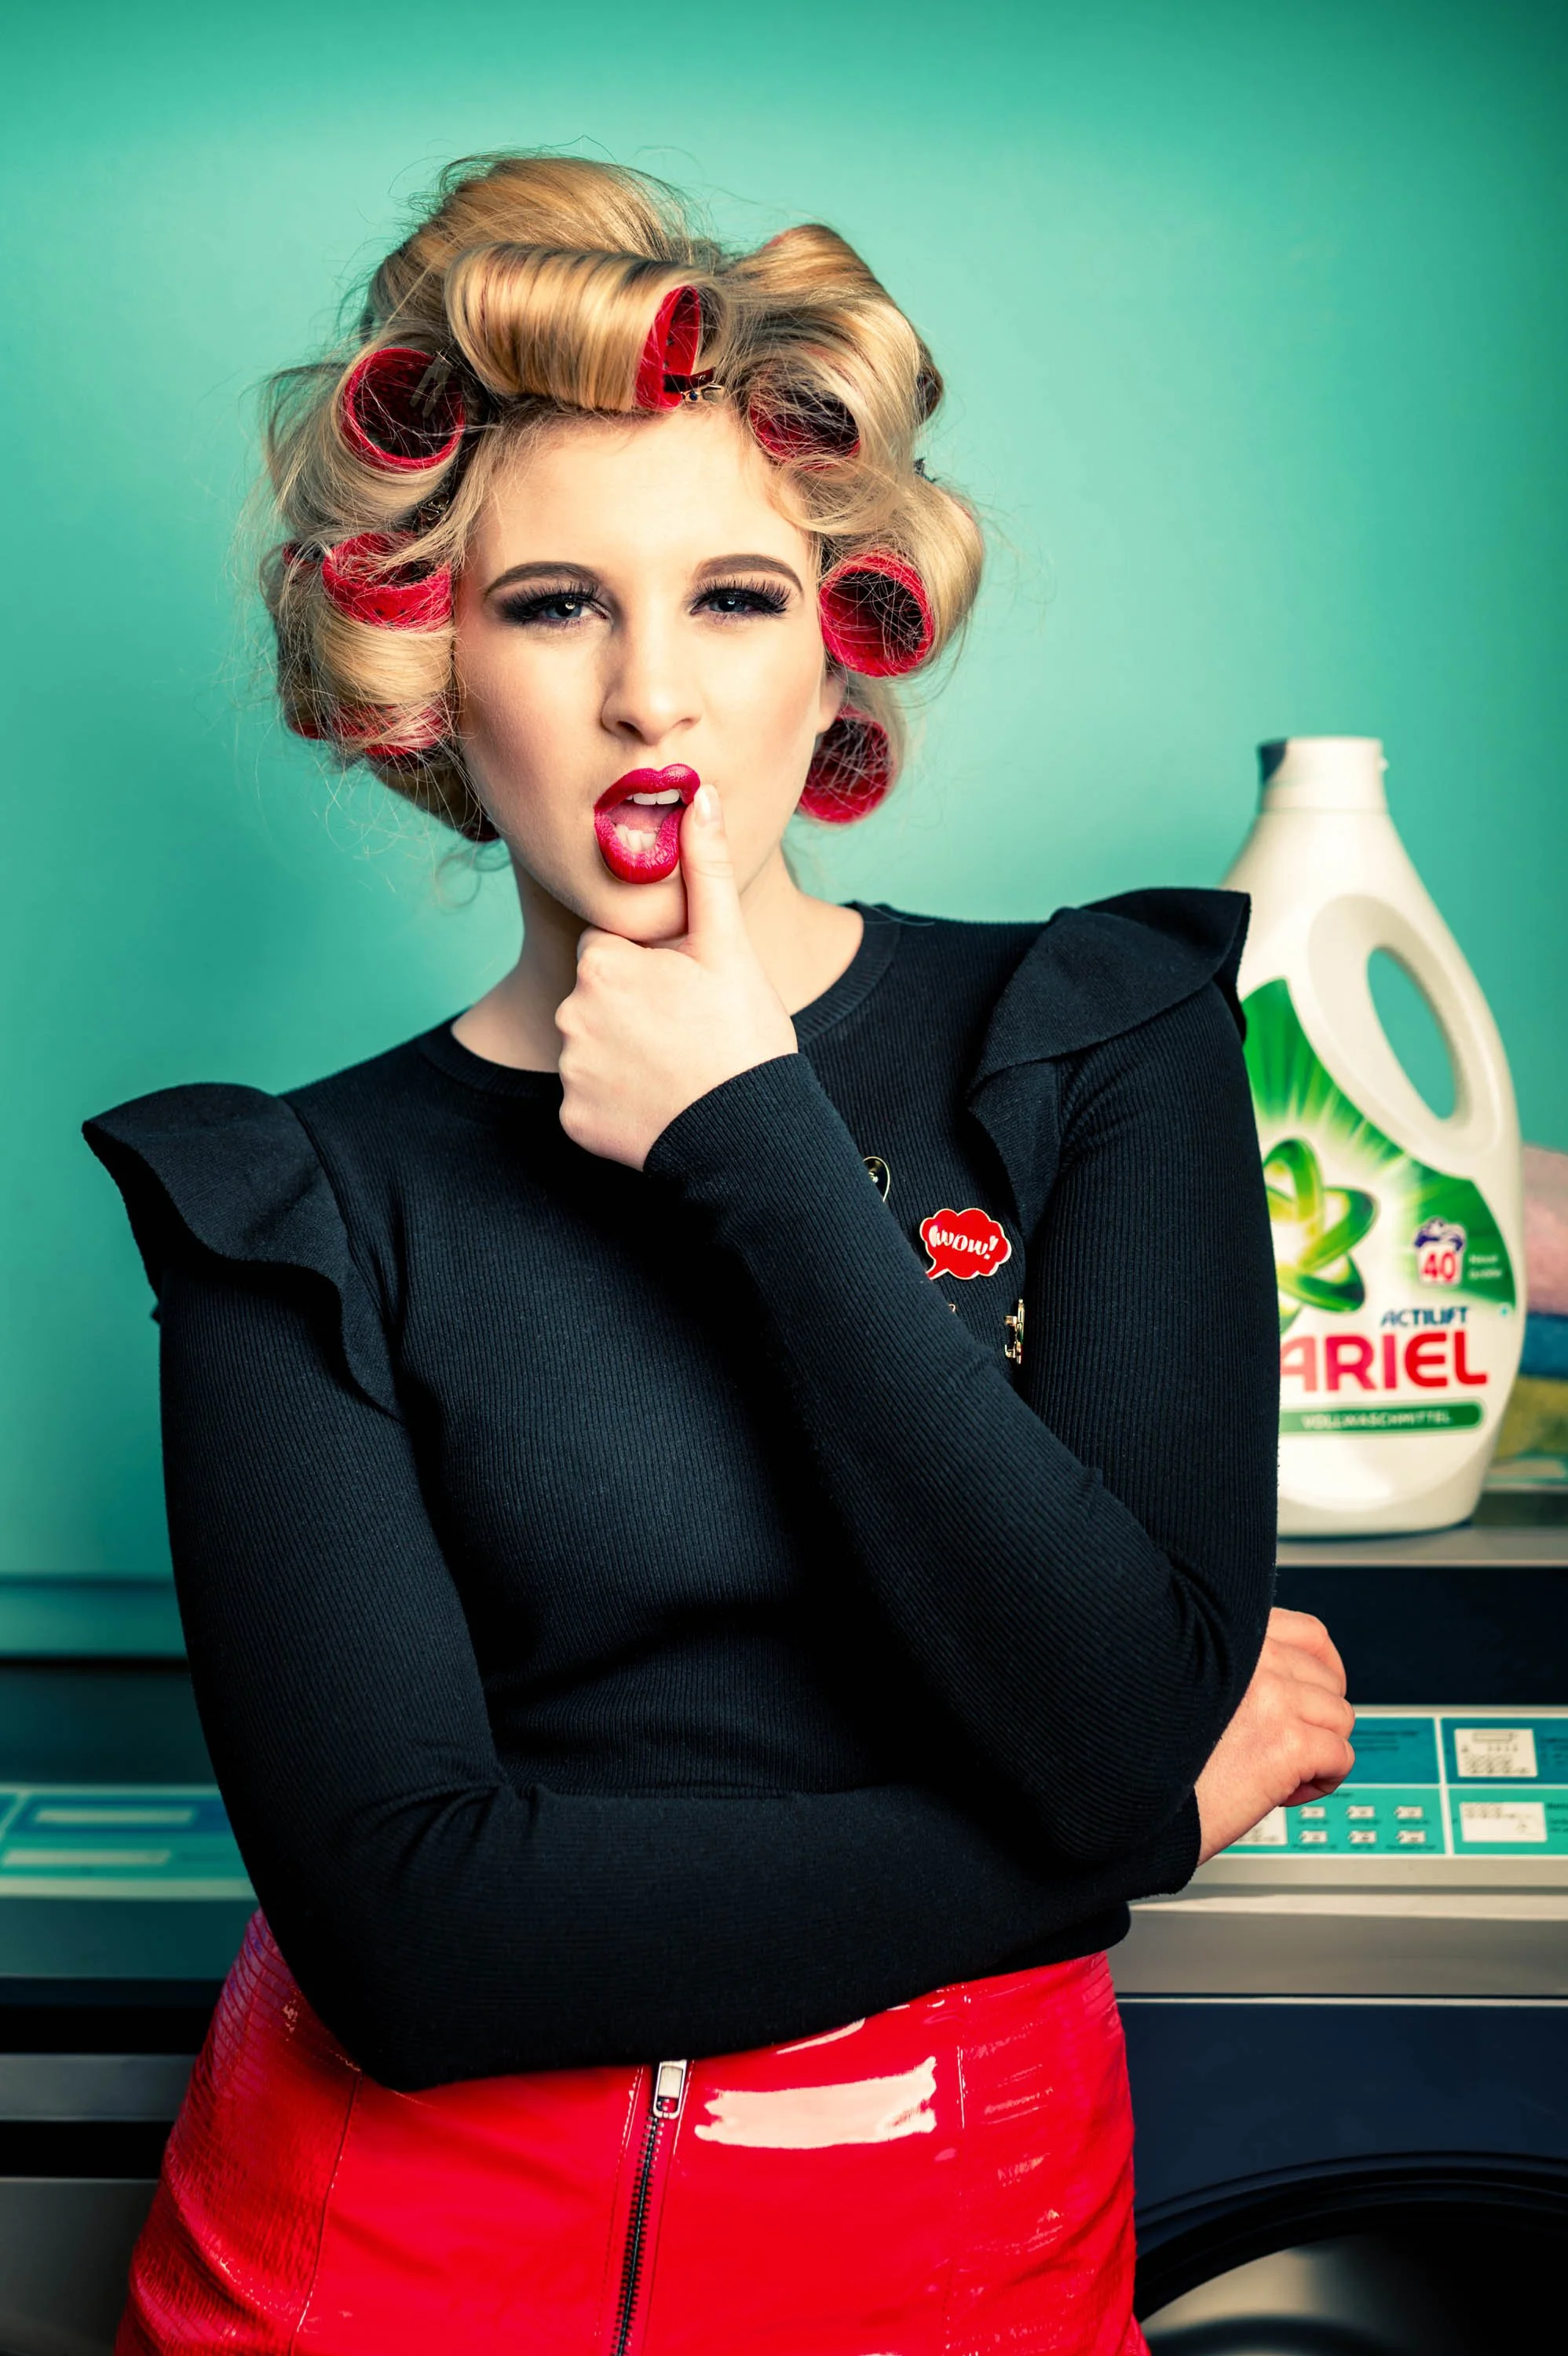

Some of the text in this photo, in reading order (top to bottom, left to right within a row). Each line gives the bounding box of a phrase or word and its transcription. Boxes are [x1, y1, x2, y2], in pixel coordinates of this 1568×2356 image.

[1422, 1252, 1457, 1283] 40
[1380, 1306, 1468, 1327] ACTILIFT
[1281, 1330, 1488, 1392] ARIEL
